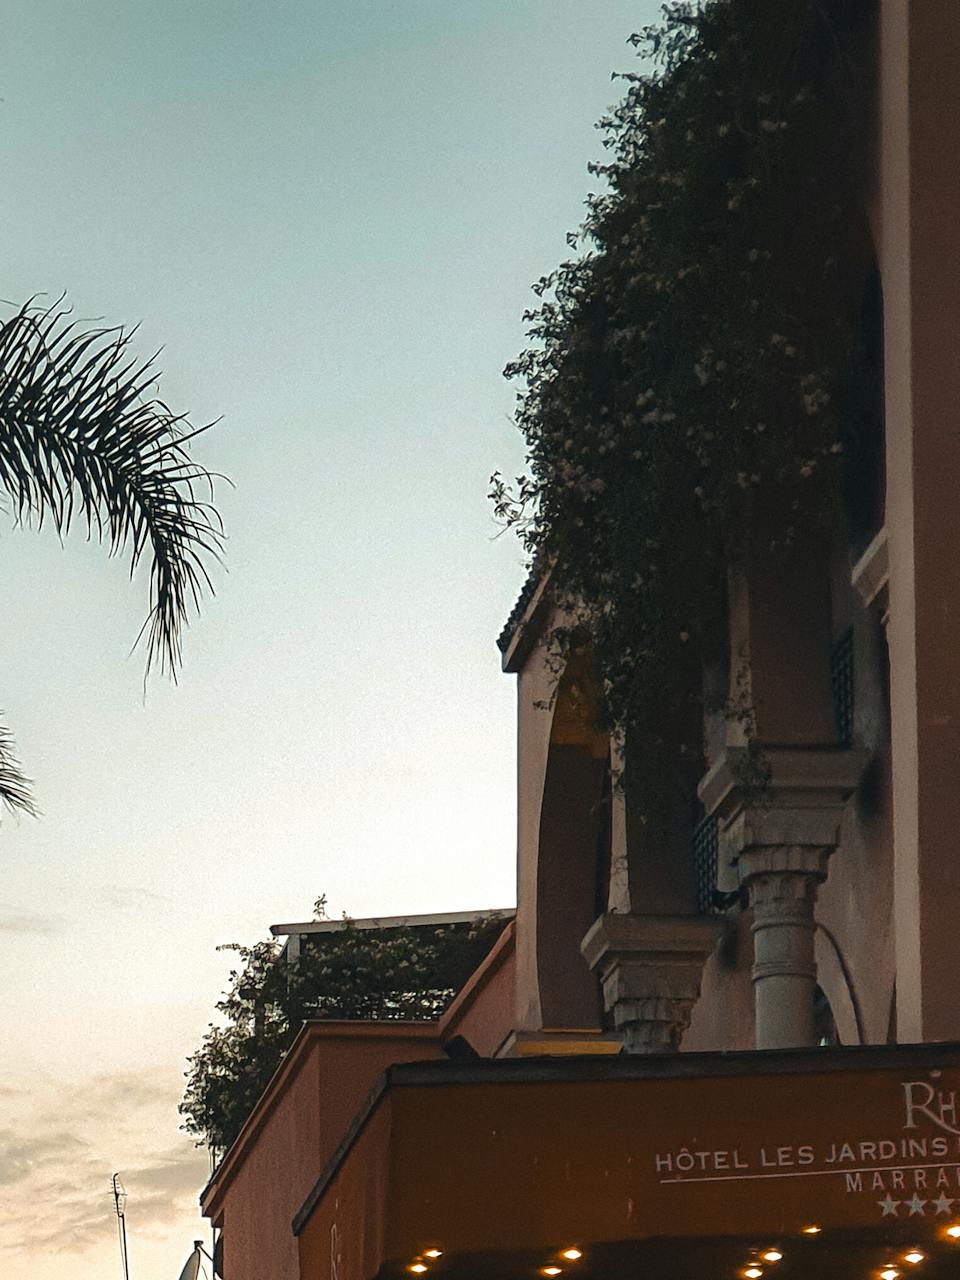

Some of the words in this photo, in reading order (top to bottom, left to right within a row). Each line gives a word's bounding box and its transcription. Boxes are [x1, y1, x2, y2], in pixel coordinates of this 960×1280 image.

[655, 1147, 749, 1172] HÔTEL
[761, 1145, 815, 1166] LES
[825, 1137, 949, 1163] JARDINS
[845, 1167, 960, 1192] MARRA
